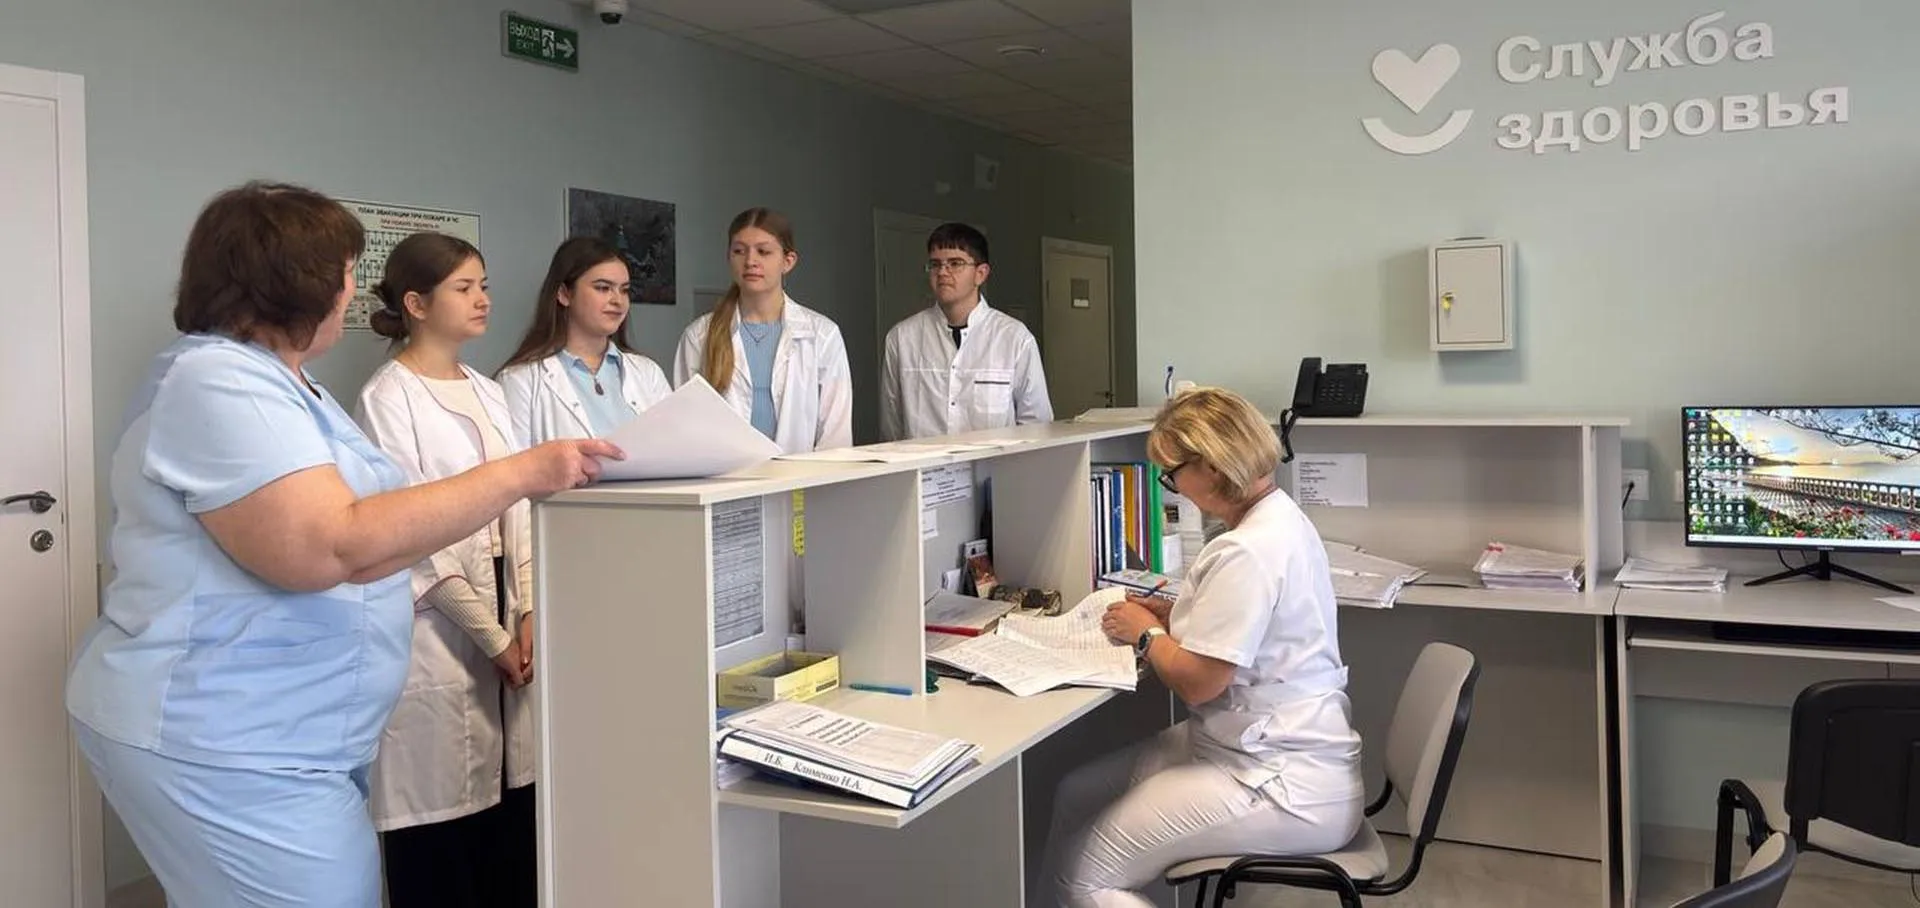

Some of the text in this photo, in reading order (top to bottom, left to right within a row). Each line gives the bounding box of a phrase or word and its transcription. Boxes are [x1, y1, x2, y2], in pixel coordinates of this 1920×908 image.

[1497, 10, 1775, 86] Служба
[1497, 86, 1849, 154] здоровья
[793, 762, 840, 783] Клименко
